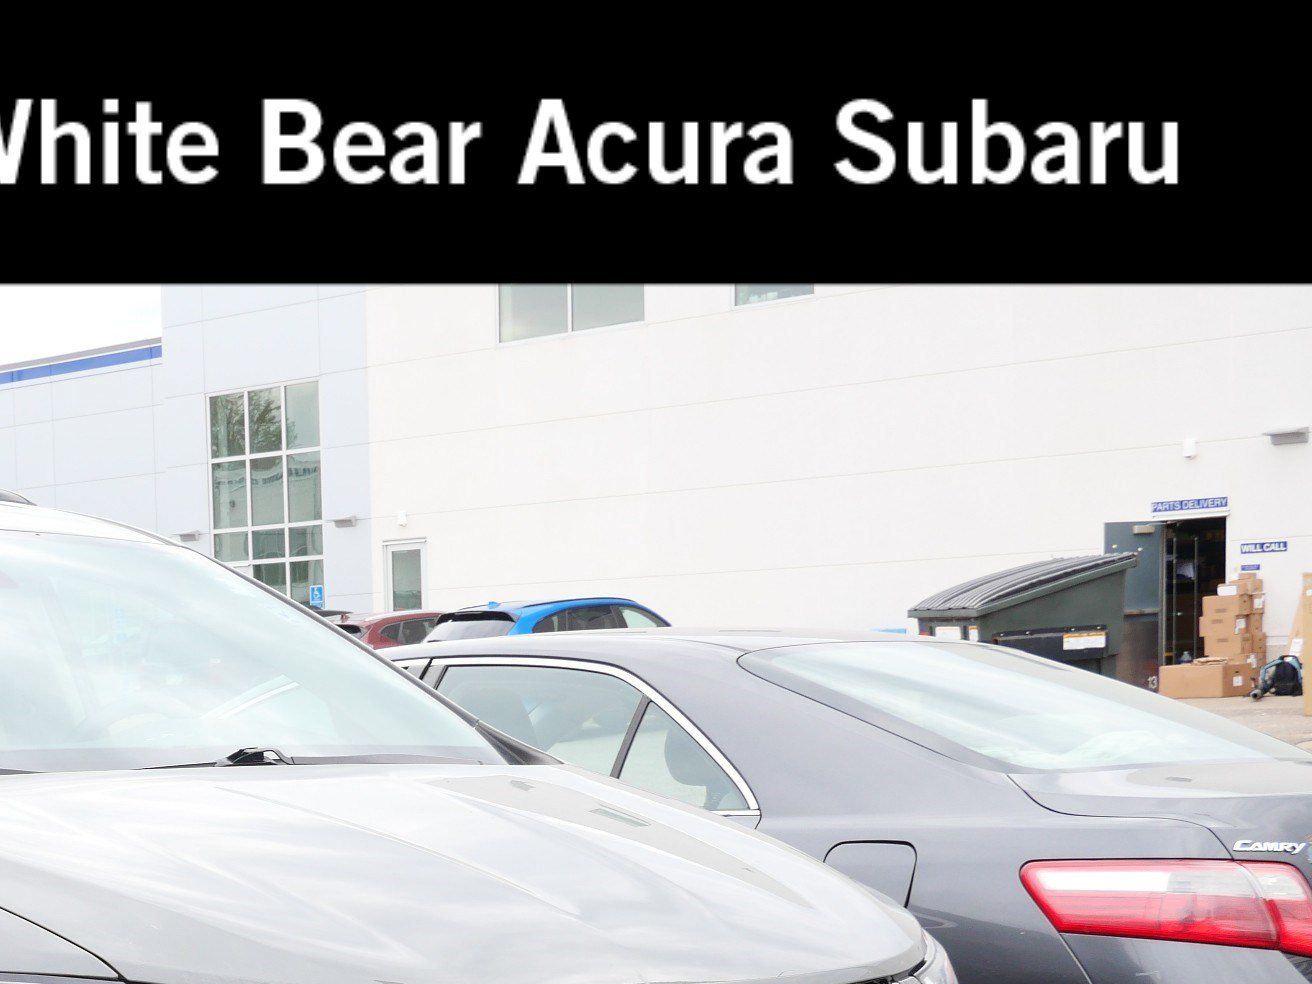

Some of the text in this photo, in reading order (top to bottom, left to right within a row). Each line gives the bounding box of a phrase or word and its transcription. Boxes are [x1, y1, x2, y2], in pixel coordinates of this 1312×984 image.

[1152, 498, 1227, 512] PARTS DELIVERY
[1241, 542, 1286, 553] WILL CALL
